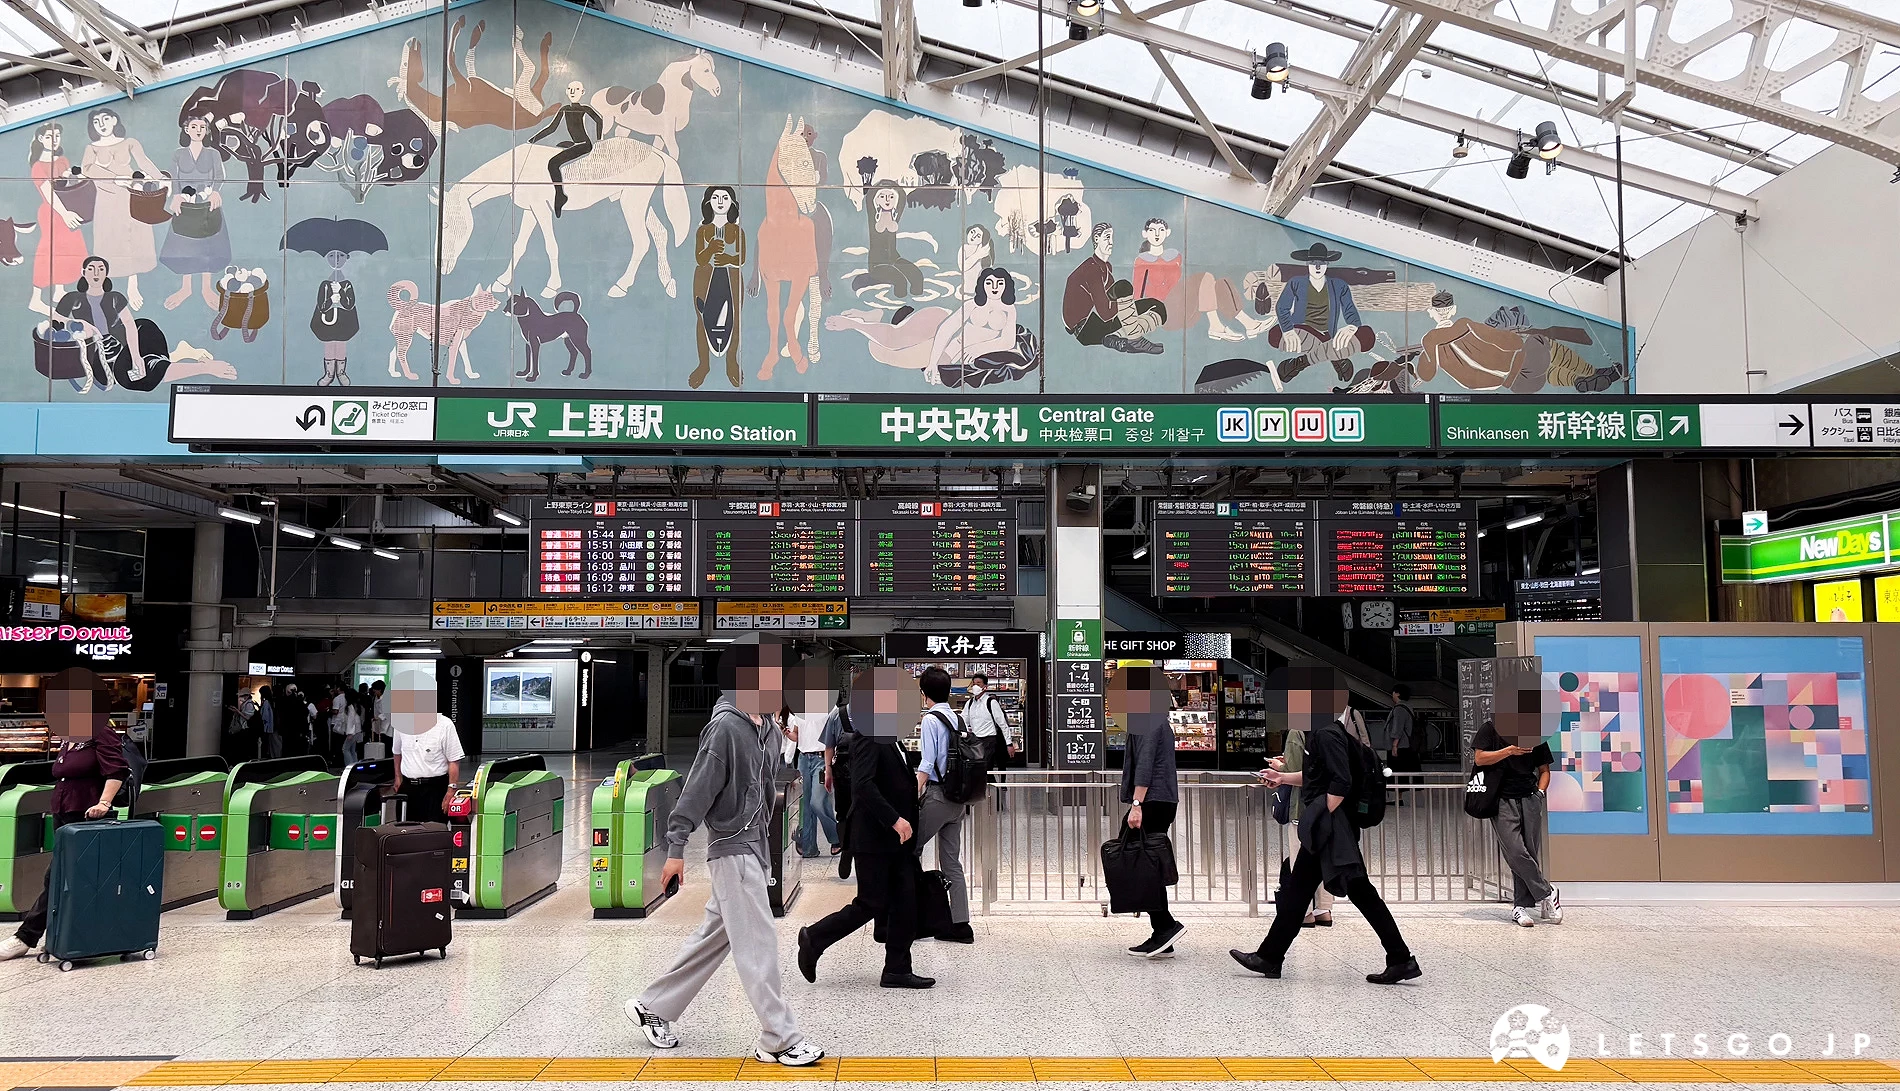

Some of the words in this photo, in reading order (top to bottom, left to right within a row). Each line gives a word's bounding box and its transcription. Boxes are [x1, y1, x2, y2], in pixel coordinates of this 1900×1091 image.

[372, 401, 427, 410] みどりの窓口
[487, 402, 537, 428] JR
[1038, 407, 1105, 422] Central
[1111, 407, 1155, 422] Gate
[1834, 408, 1853, 416] バス
[548, 403, 664, 439] 上野駅
[880, 407, 1028, 442] 中央改札
[1224, 418, 1244, 431] JK
[1262, 418, 1281, 431] JY
[1299, 418, 1319, 431] JU
[1339, 418, 1354, 431] JJ
[1537, 411, 1627, 440] 新幹線
[493, 430, 530, 438] JR東日本
[675, 425, 725, 441] Ueno
[730, 425, 796, 441] Station
[1038, 428, 1113, 442] 中央检票口
[1125, 428, 1154, 442] 중앙
[1161, 428, 1206, 442] 개찰구
[1447, 427, 1529, 440] Shinkansen
[1822, 427, 1854, 436] タクシー
[544, 501, 592, 509] 上野東京ライン
[596, 504, 606, 512] JU
[760, 504, 770, 513] JU
[922, 504, 932, 512] JU
[1219, 505, 1228, 513] JJ
[587, 530, 614, 539] 15:44
[619, 530, 636, 539] 品川
[587, 541, 614, 549] 15:51
[619, 541, 643, 549] 小田原
[1800, 530, 1882, 562] NewDays
[587, 552, 614, 560] 16:00
[619, 552, 635, 560] 平塚
[587, 562, 614, 571] 16:03
[619, 562, 636, 571] 品川
[545, 573, 561, 582] 特急
[587, 573, 614, 582] 16:09
[619, 573, 636, 582] 品川
[587, 584, 614, 592] 16:12
[619, 584, 635, 592] 伊東
[59, 625, 133, 641] Donut
[76, 644, 132, 655] KIOSK
[926, 635, 998, 655] 駅弁屋
[1103, 640, 1117, 650] HE
[1120, 640, 1144, 650] GIFT
[1147, 640, 1176, 650] SHOP
[1068, 671, 1089, 682] 1~4
[451, 679, 459, 723] Information
[1067, 708, 1092, 719] 5~12
[1066, 743, 1095, 754] 13~17
